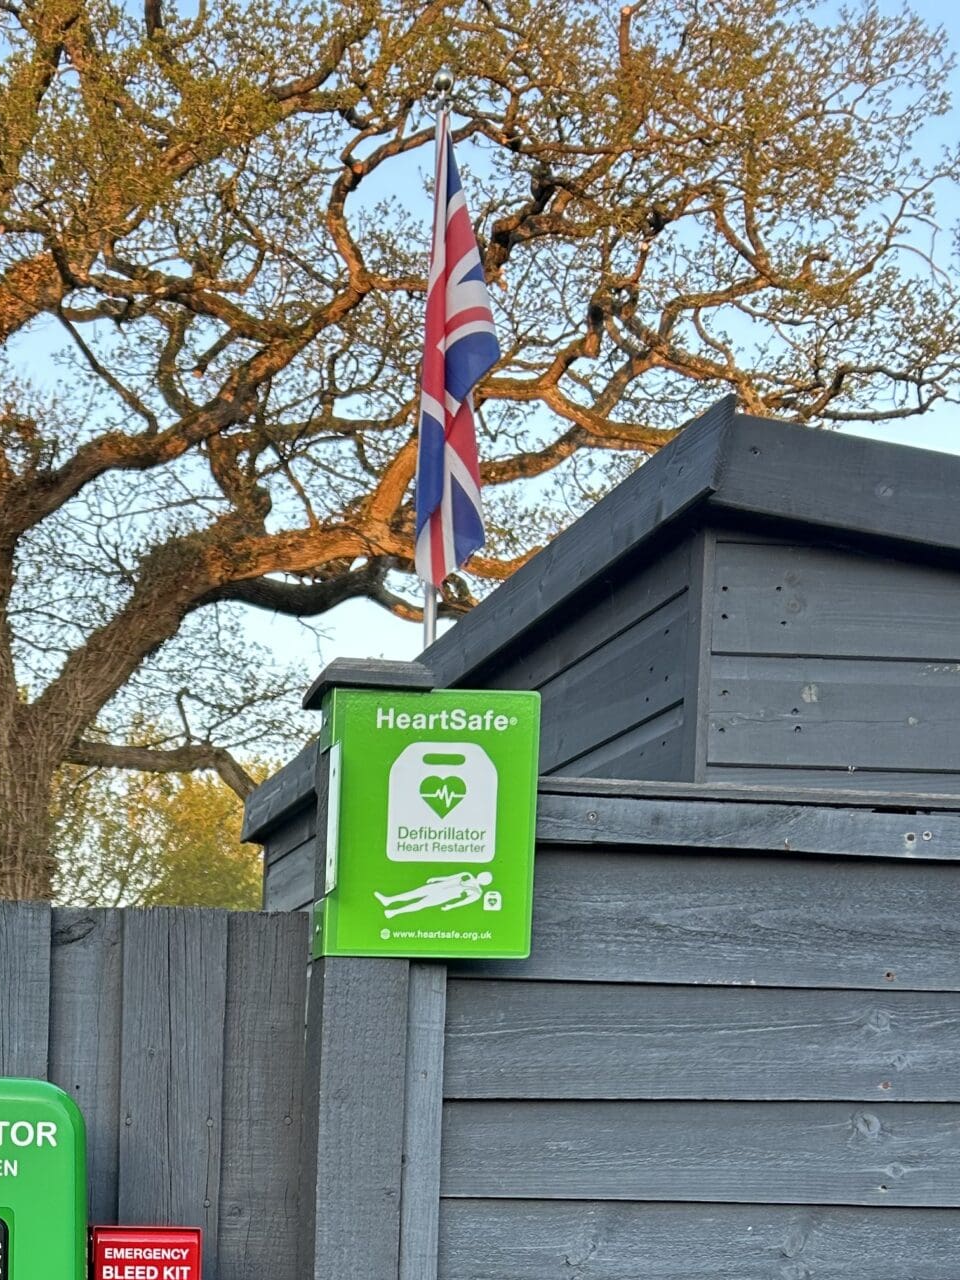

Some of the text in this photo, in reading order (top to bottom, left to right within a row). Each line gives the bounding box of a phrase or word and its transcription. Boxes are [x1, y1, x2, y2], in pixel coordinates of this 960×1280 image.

[398, 826, 487, 841] Defibrillator
[397, 842, 486, 853] Heart Restarter
[393, 929, 492, 941] www.heartsafe.org.uk
[104, 1248, 190, 1260] EMERGENCY
[102, 1266, 191, 1280] BLEED KIT
